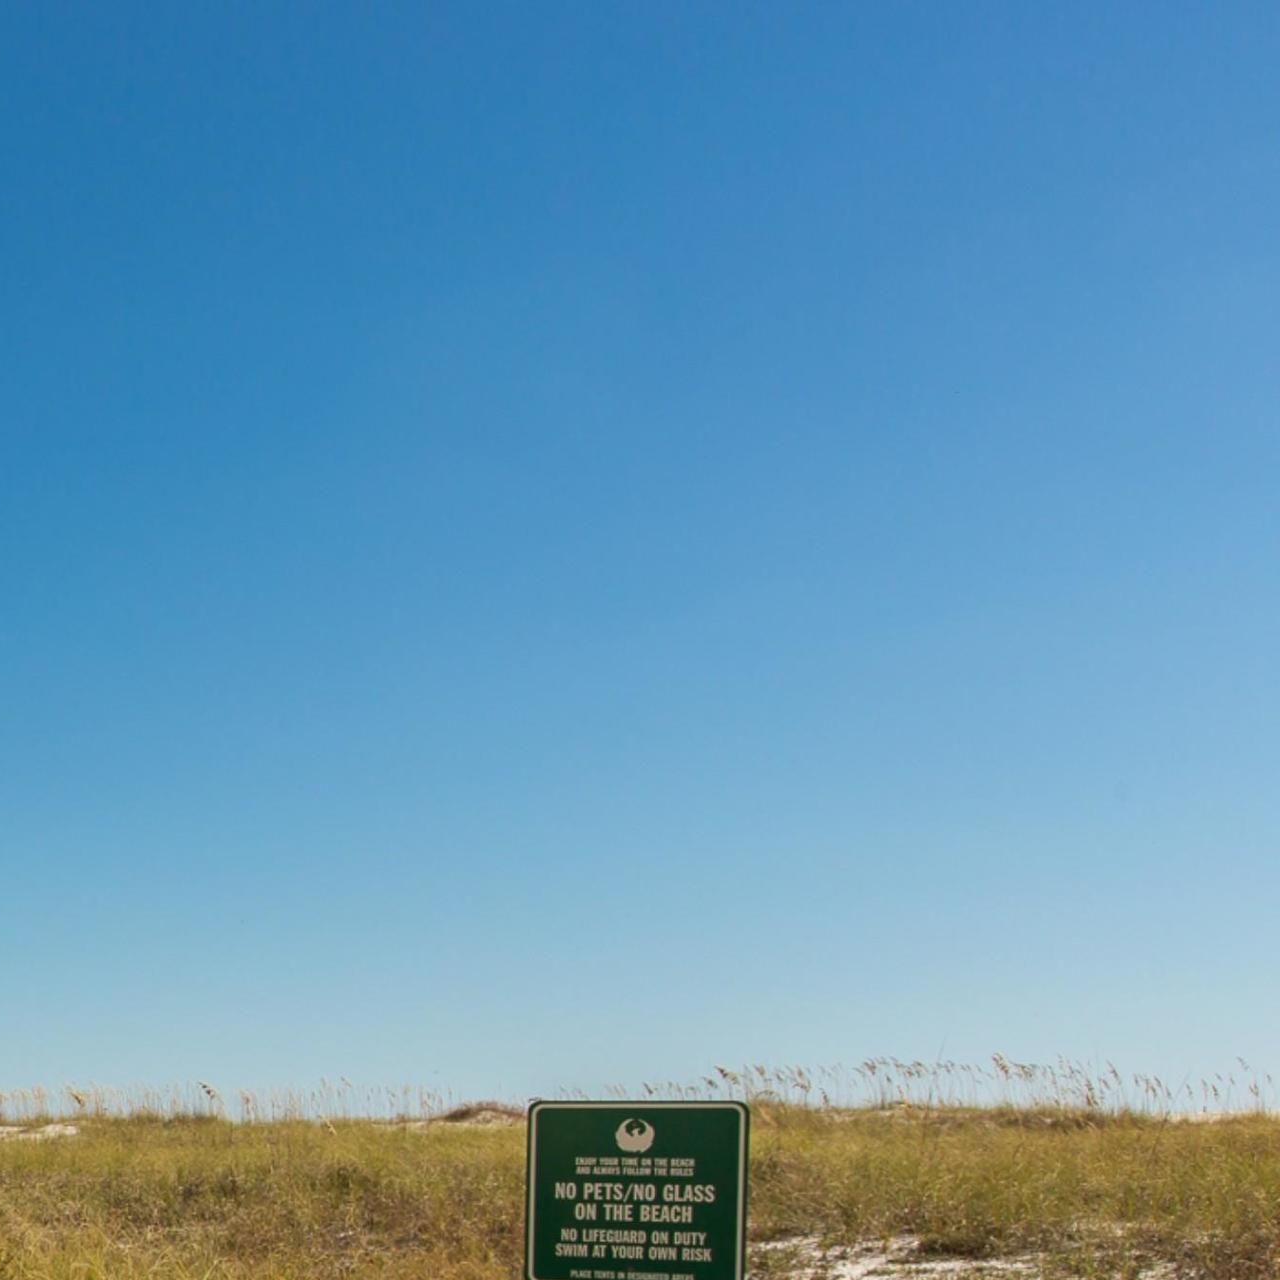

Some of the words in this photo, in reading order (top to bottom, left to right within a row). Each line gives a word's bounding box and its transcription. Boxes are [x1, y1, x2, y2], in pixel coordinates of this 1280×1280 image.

[654, 1158, 668, 1167] THE
[654, 1168, 668, 1176] THE
[555, 1182, 577, 1199] NO
[583, 1183, 656, 1202] PETS/NO
[663, 1184, 716, 1203] GLASS
[575, 1203, 597, 1220] ON
[603, 1204, 633, 1221] THE
[640, 1204, 693, 1223] BEACH
[560, 1228, 577, 1241] NO
[582, 1229, 647, 1244] LIFEGUARD
[651, 1231, 668, 1244] ON
[674, 1232, 707, 1246] DUTY
[555, 1243, 588, 1257] SWIM
[592, 1245, 607, 1257] AT
[611, 1245, 644, 1259] YOUR
[648, 1246, 677, 1261] OWN
[682, 1248, 712, 1262] RISK
[617, 1271, 626, 1279] IN
